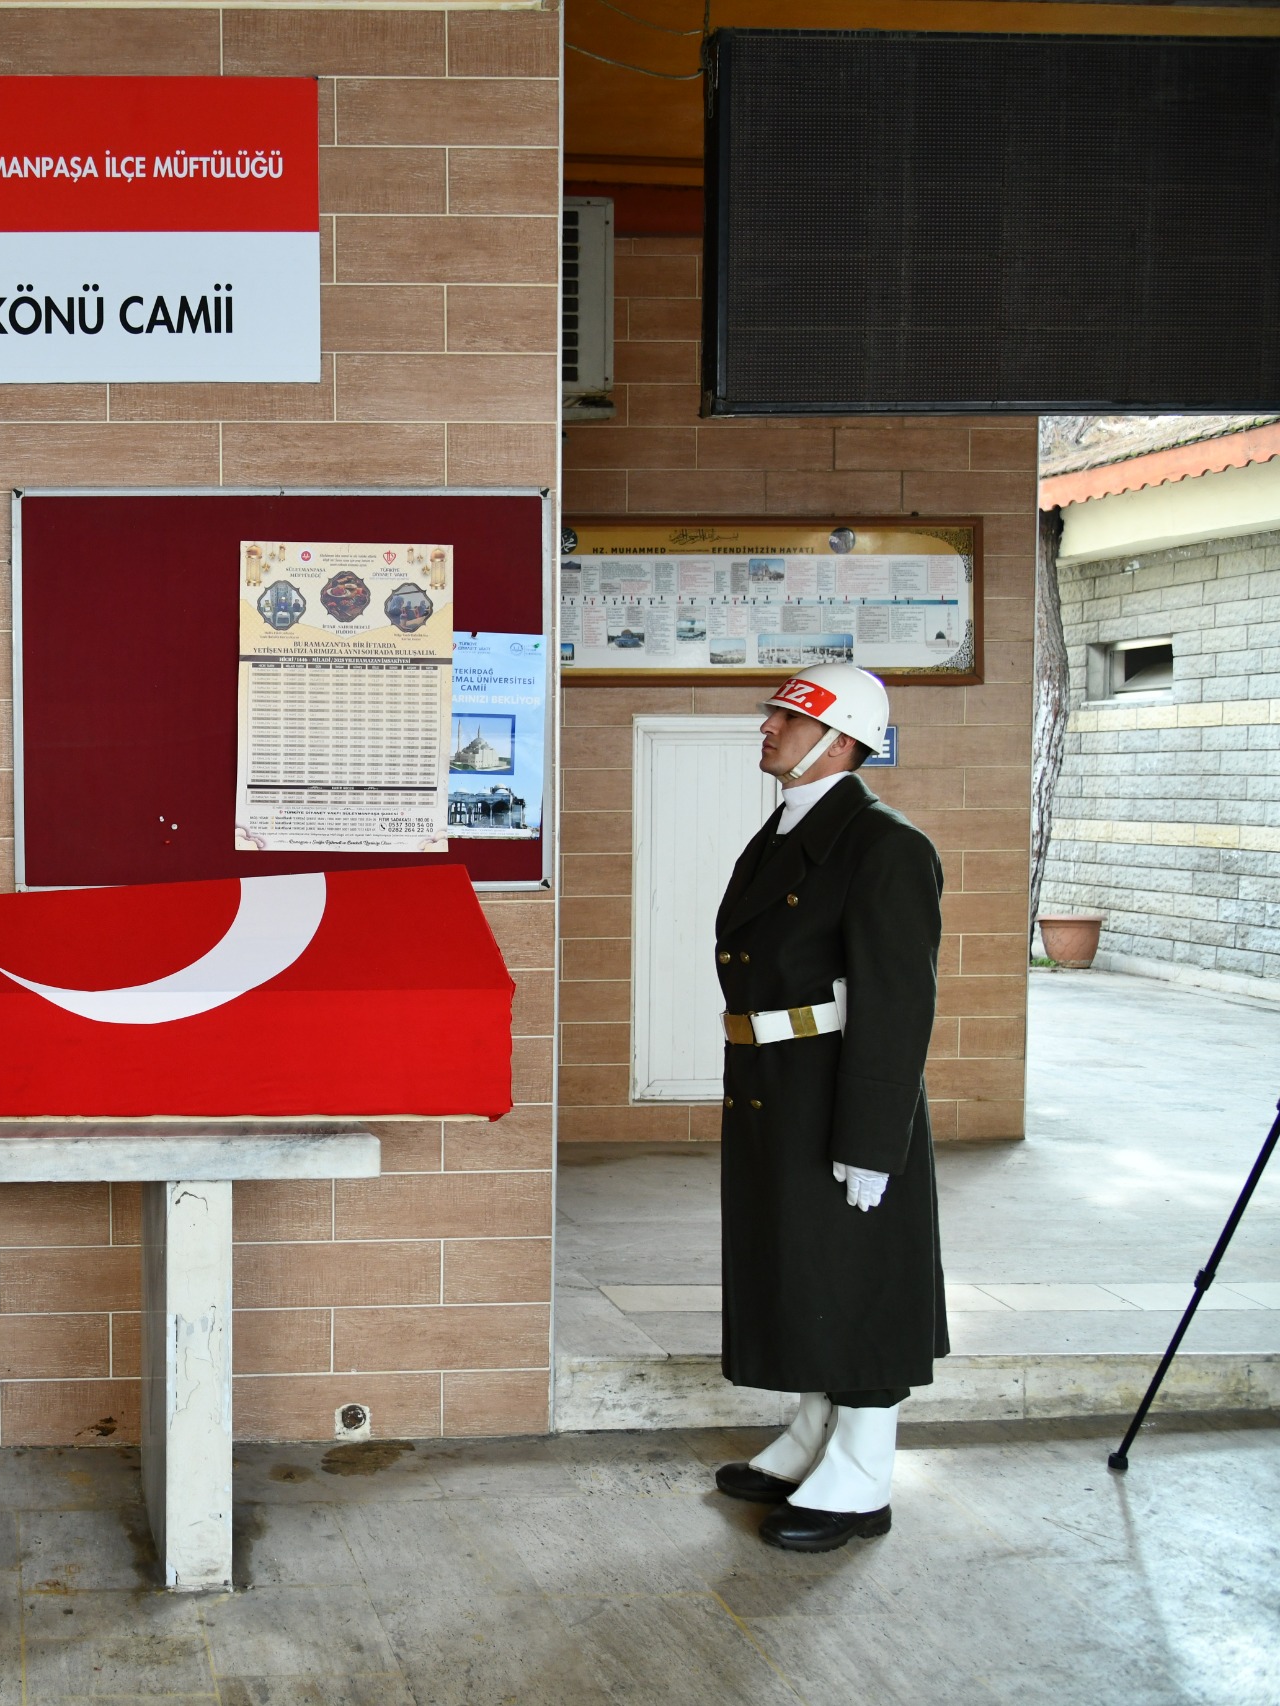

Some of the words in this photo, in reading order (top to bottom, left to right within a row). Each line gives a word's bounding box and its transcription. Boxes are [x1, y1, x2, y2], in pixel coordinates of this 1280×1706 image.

[105, 150, 146, 183] İLÇE
[153, 150, 283, 179] MÜFTÜLÜĞÜ
[119, 283, 233, 335] CAMİİ
[712, 546, 776, 554] EFENDİMİZİN
[454, 667, 494, 675] TEKİRDAĞ
[476, 675, 535, 685] ÜNİVERSİTESİ
[460, 684, 486, 692] CAMİİ
[452, 694, 488, 704] ARINIZI
[492, 695, 541, 706] BEKLİYOR
